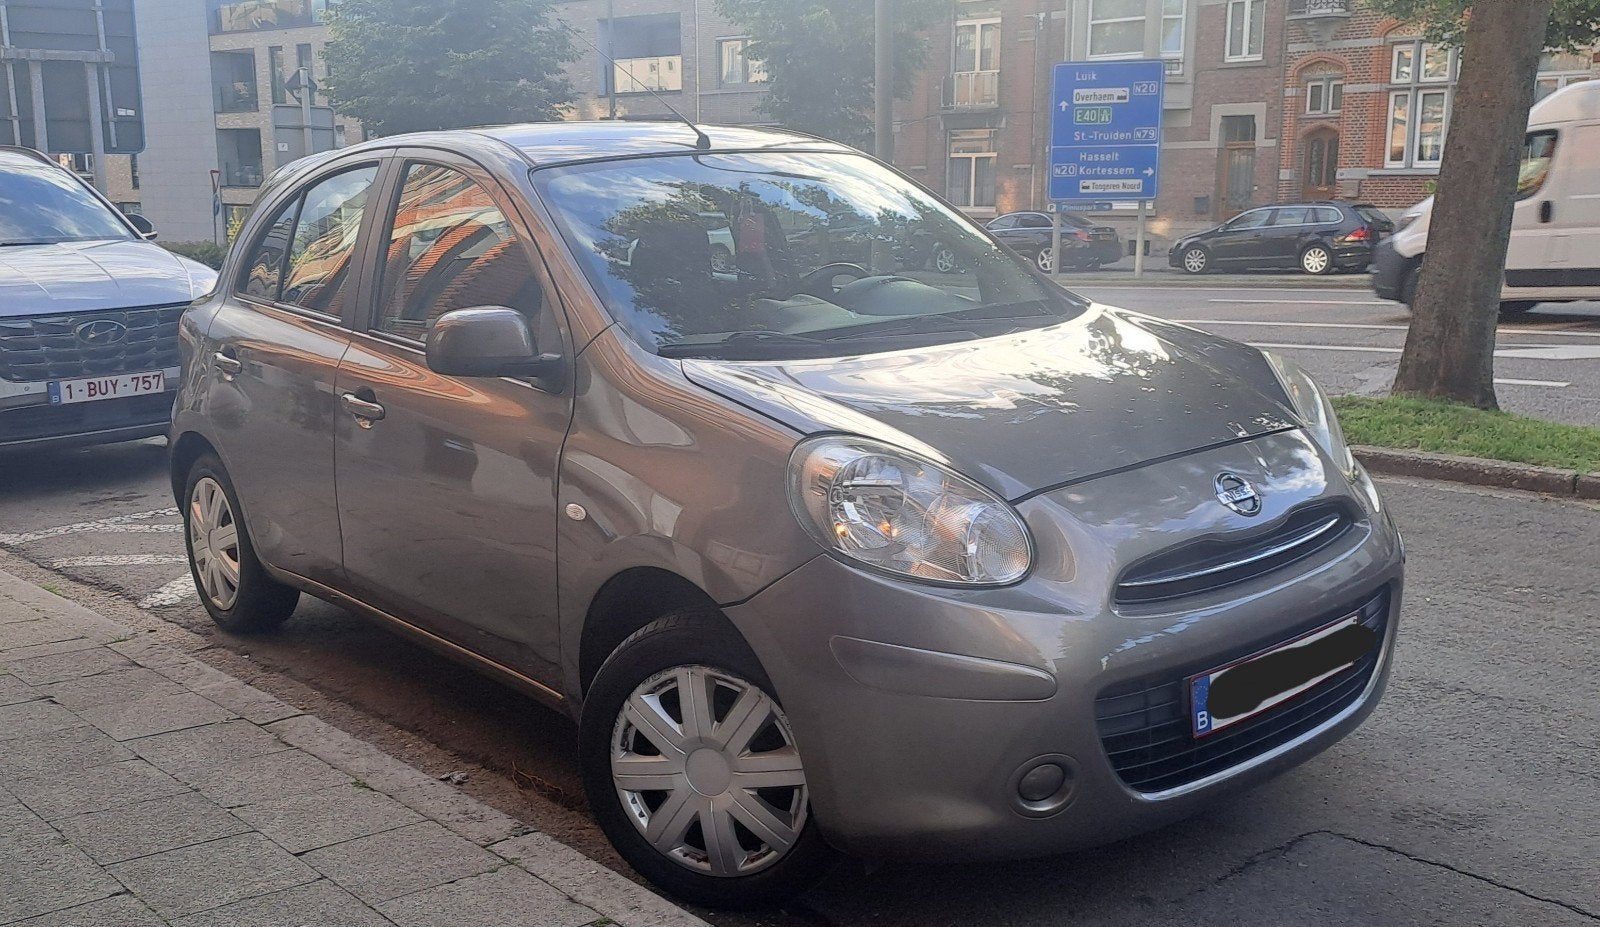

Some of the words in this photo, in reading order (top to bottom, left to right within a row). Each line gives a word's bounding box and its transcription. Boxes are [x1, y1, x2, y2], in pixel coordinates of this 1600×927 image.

[1075, 72, 1097, 81] Luik
[1135, 83, 1157, 94] N20
[1075, 92, 1115, 102] Overhaem
[1076, 110, 1097, 122] E40
[1135, 129, 1155, 139] N79
[1080, 152, 1120, 161] Hasselt
[1054, 165, 1076, 175] N20
[1079, 165, 1135, 175] Kortessem
[1197, 710, 1209, 730] B
